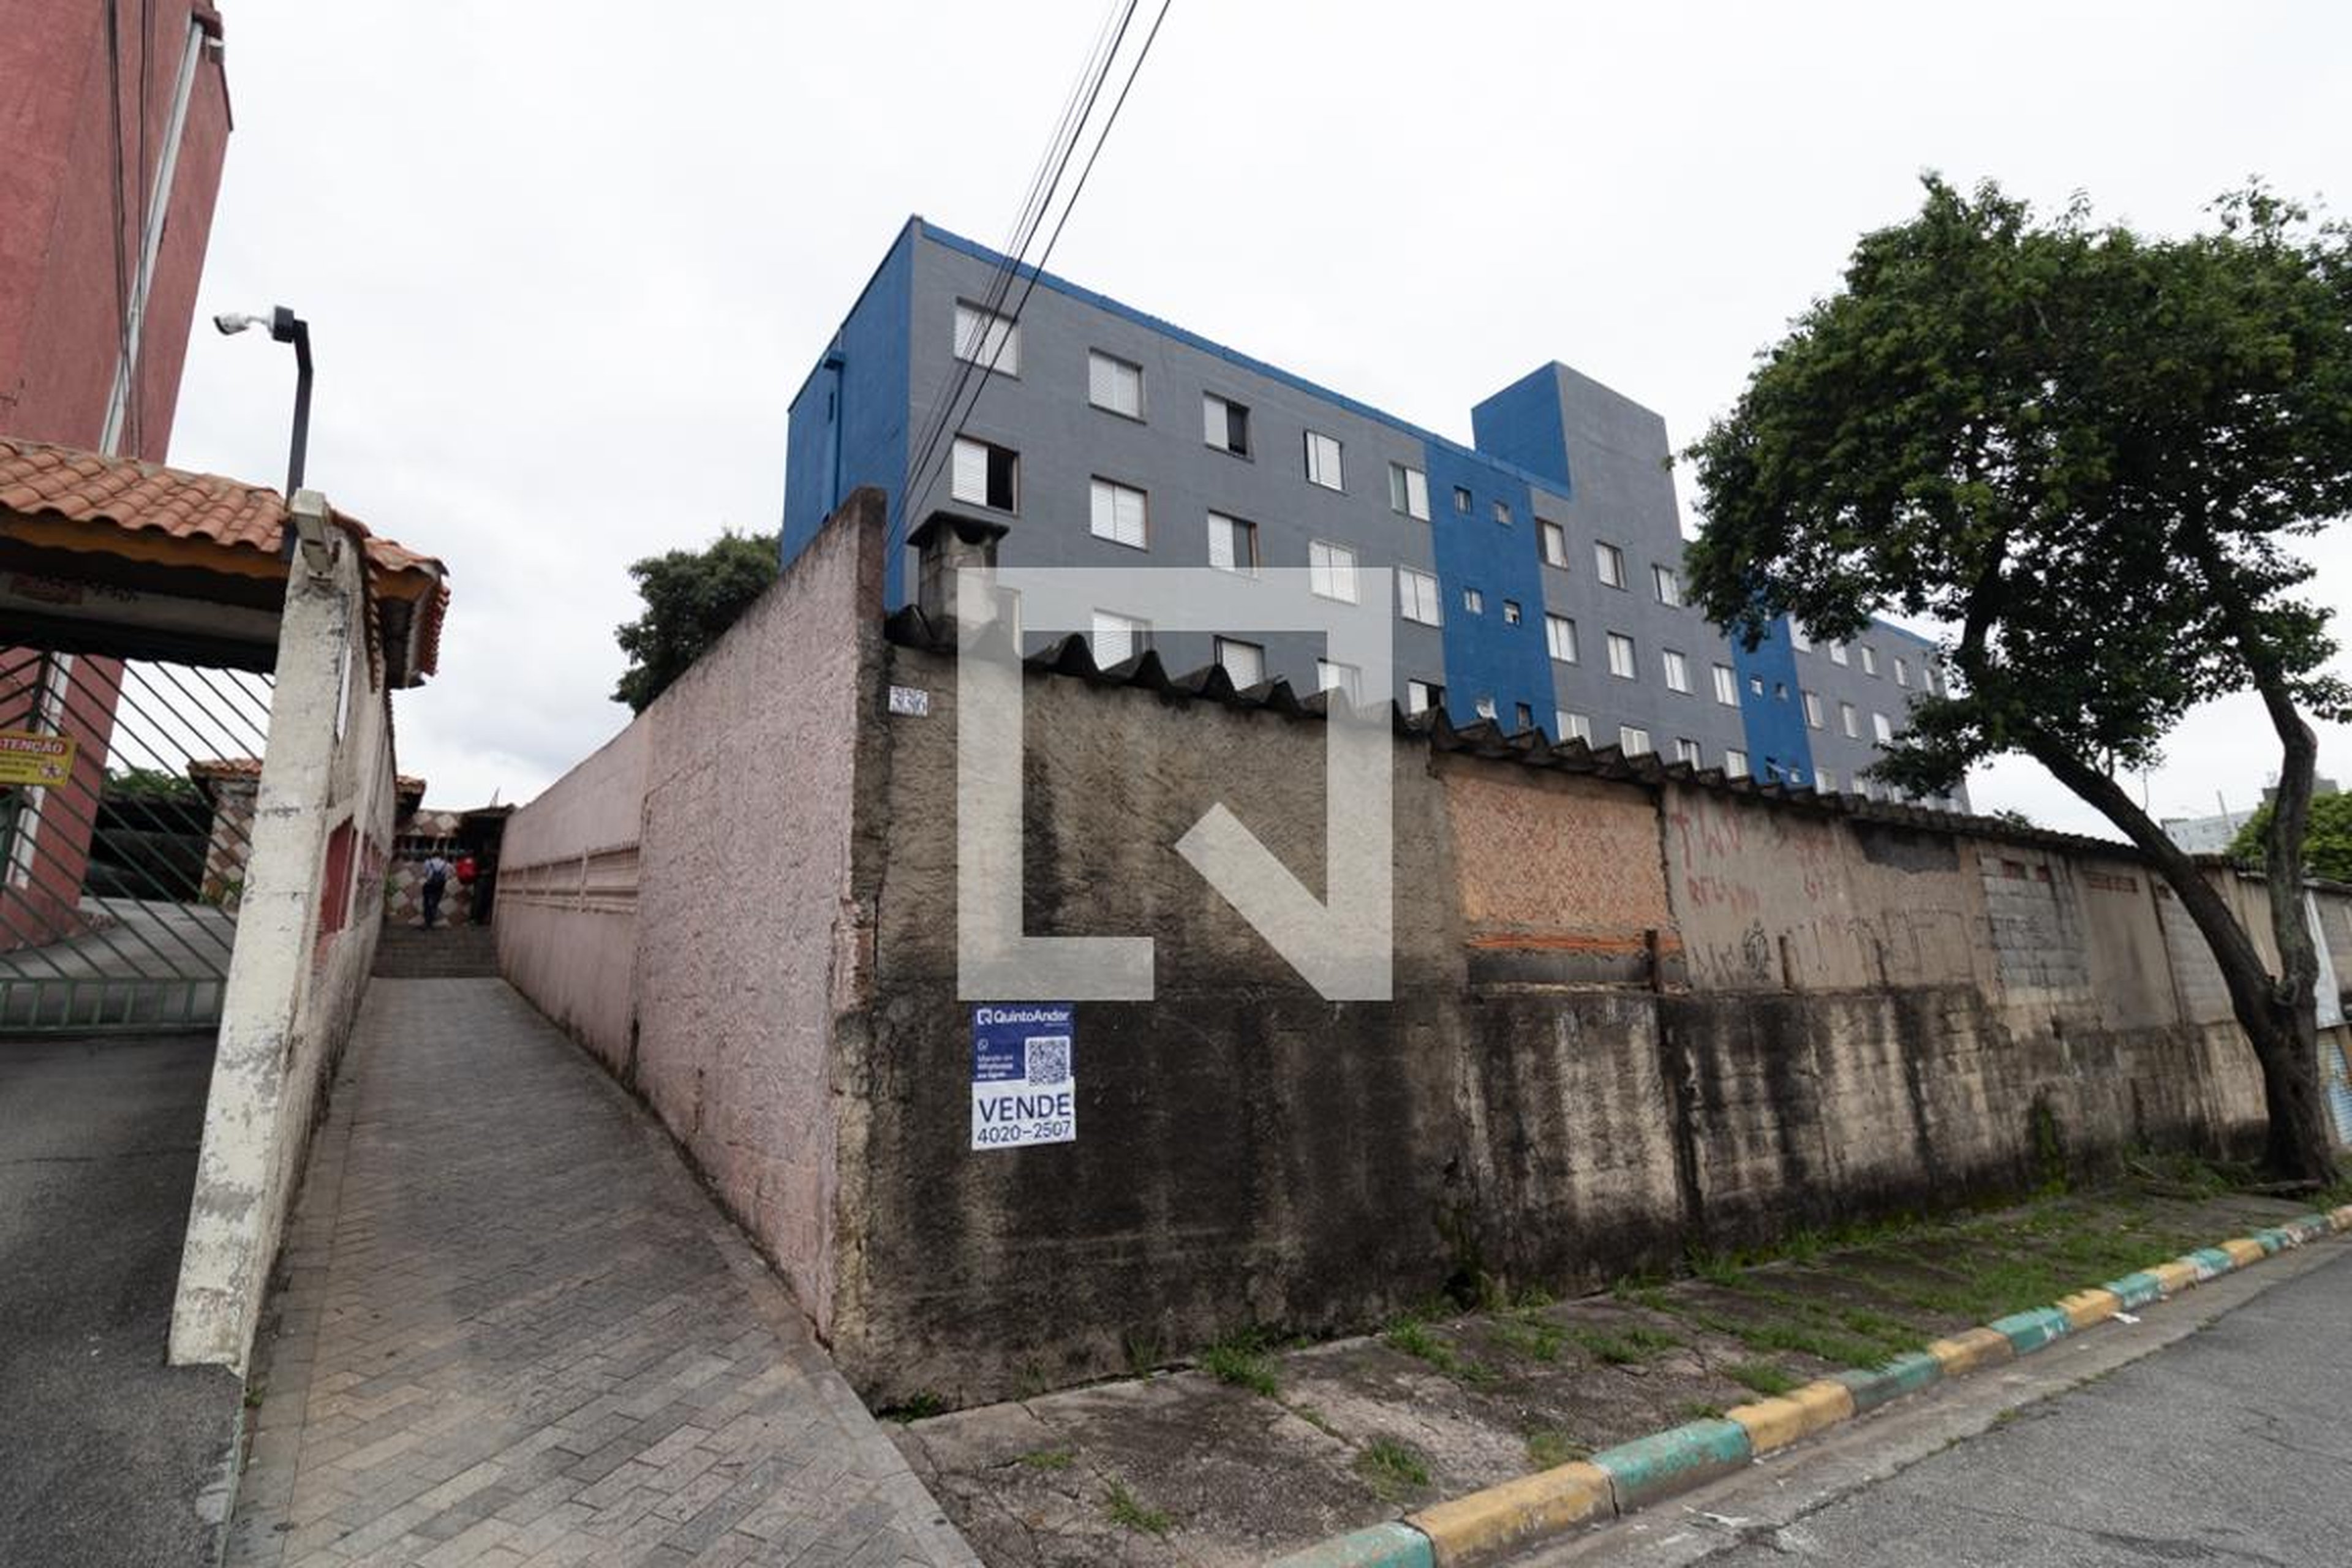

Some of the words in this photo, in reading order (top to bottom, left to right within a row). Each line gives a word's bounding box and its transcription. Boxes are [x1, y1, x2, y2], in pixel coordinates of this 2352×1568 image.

[994, 1009, 1070, 1023] QuintoAndar
[978, 1093, 1071, 1123] VENDE
[978, 1120, 1071, 1144] 4020-2507
